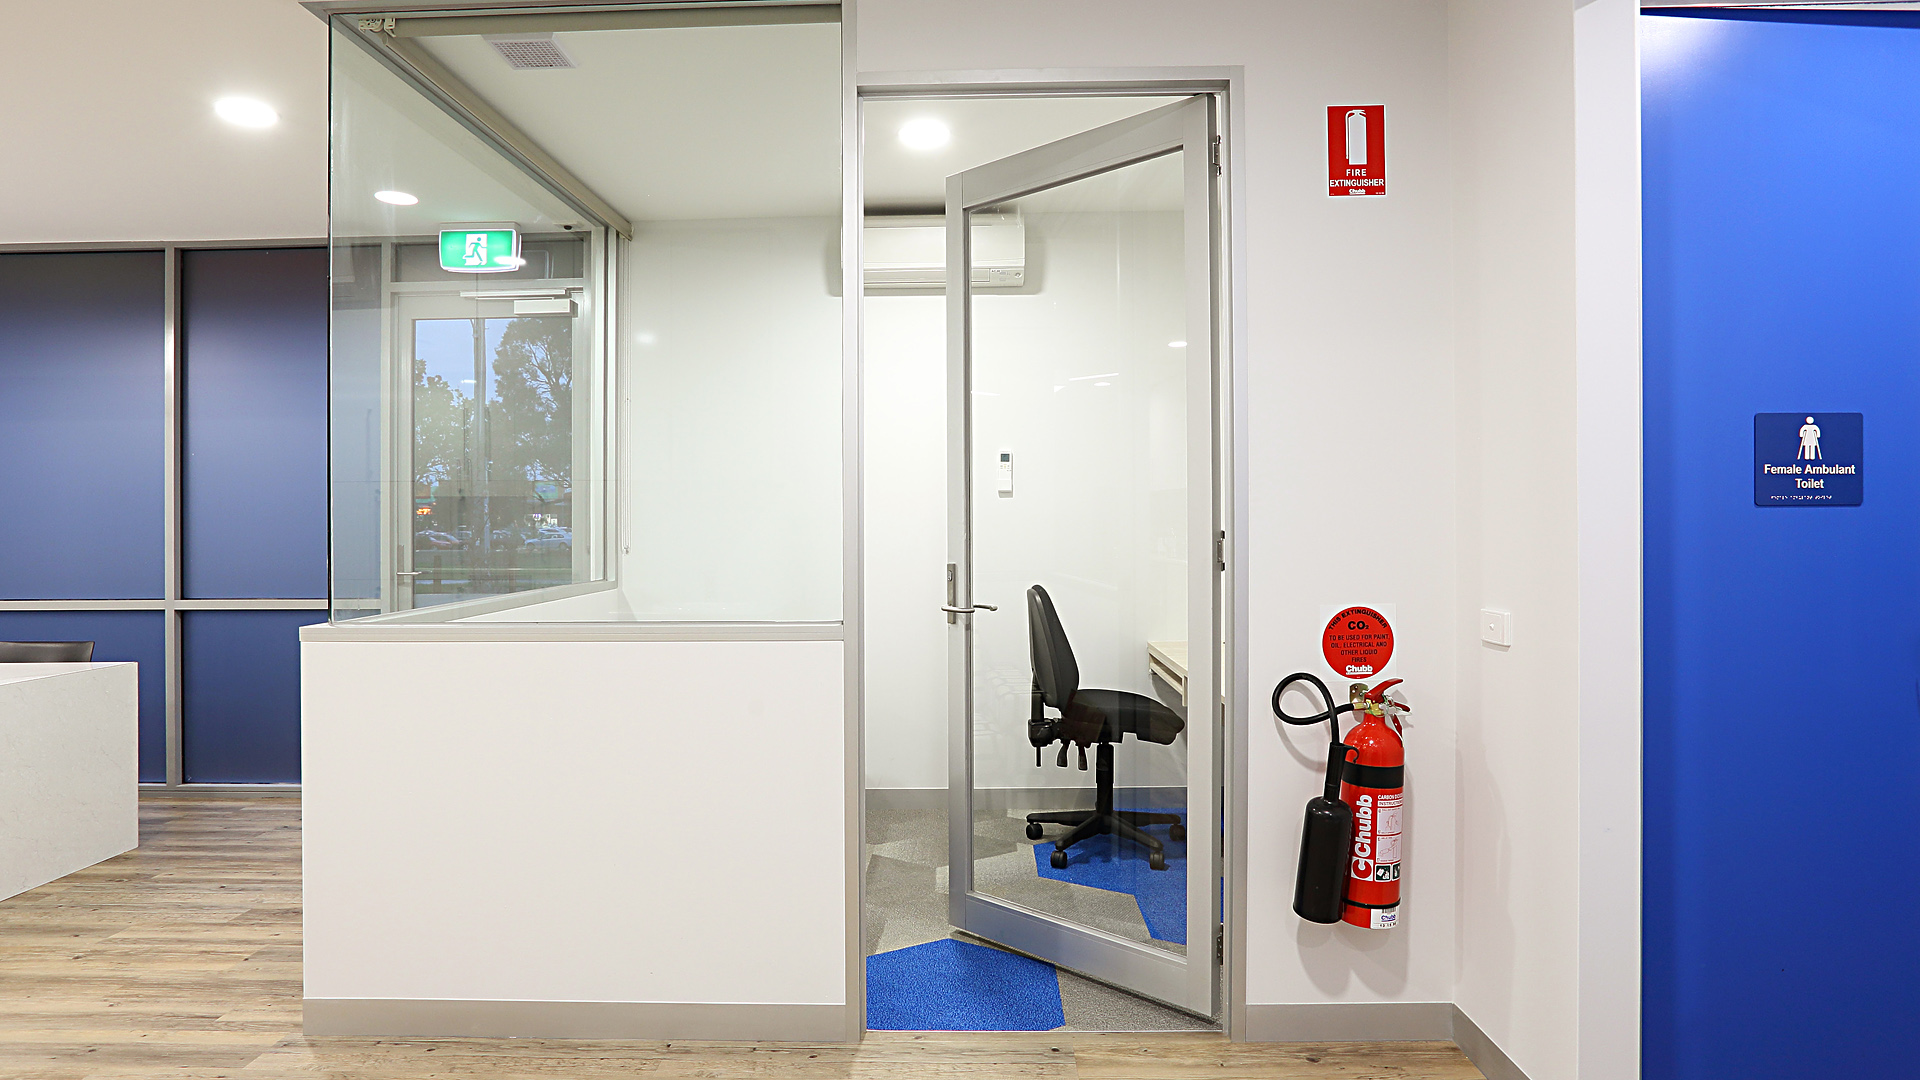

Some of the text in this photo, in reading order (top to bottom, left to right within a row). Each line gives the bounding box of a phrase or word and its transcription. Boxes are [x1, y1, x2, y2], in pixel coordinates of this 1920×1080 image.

[1346, 168, 1367, 177] FIRE
[1329, 178, 1385, 188] EXTINGUISHER
[1764, 463, 1856, 475] Female Ambulant
[1795, 478, 1824, 489] Toilet
[1328, 608, 1388, 630] THIS EXTINGUISHER
[1345, 664, 1374, 673] Chubb
[1354, 794, 1373, 858] Chubb
